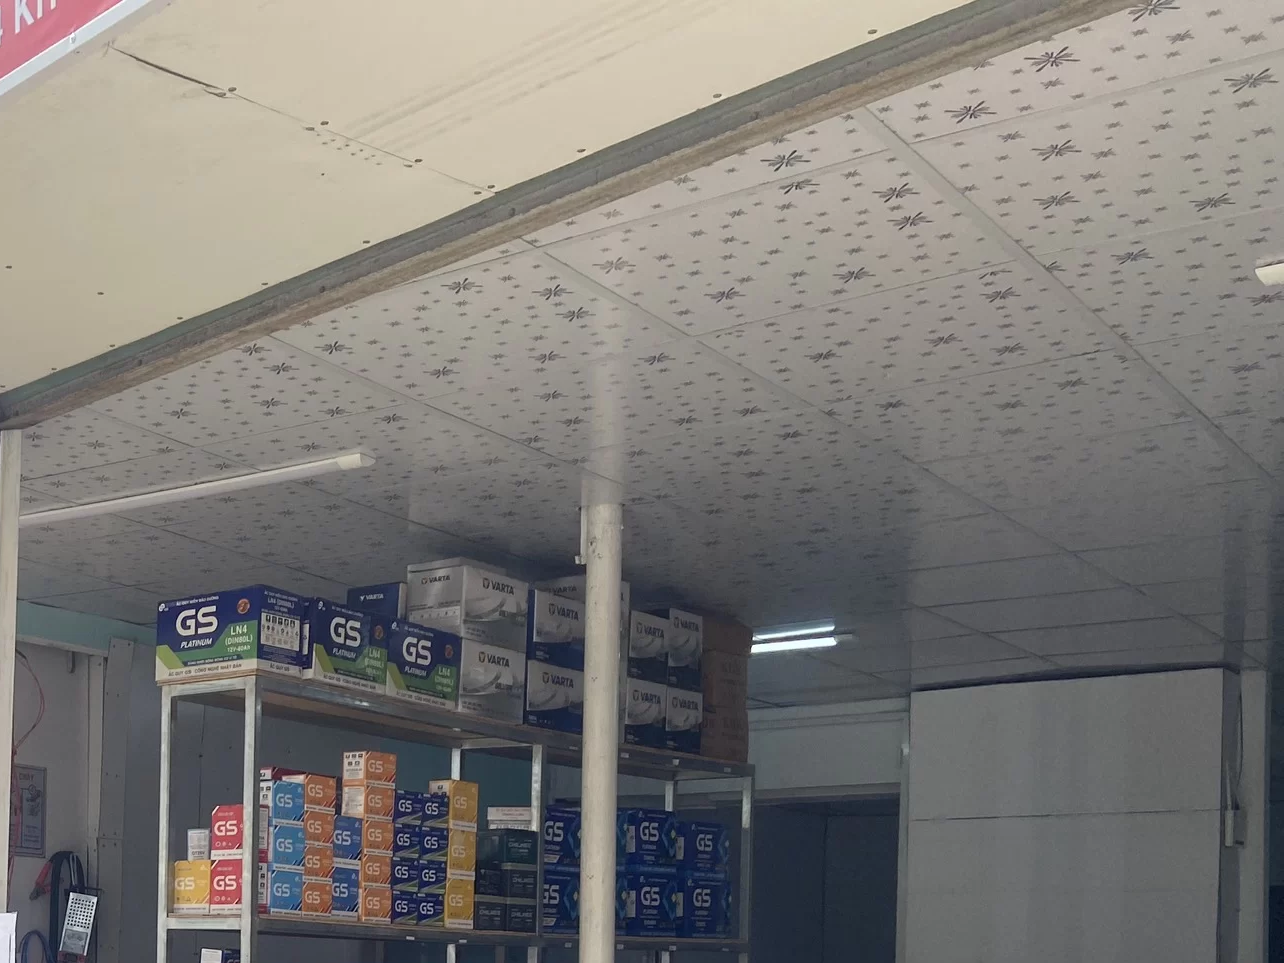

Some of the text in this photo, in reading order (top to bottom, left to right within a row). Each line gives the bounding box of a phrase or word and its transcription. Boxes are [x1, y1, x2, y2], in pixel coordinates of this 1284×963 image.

[490, 581, 515, 595] VARTA
[176, 605, 218, 636] GS
[230, 625, 248, 635] LN4
[330, 617, 361, 647] GS
[180, 638, 212, 649] PLATINUM
[403, 637, 432, 666] GS
[486, 655, 510, 668] VARTA
[368, 759, 384, 773] GS
[276, 793, 293, 807] GS
[398, 800, 413, 812] GS
[214, 821, 238, 836] GS
[544, 821, 564, 842] GS
[640, 821, 659, 842] GS
[333, 830, 351, 845] GS
[175, 877, 195, 890] GS
[213, 875, 237, 890] GS
